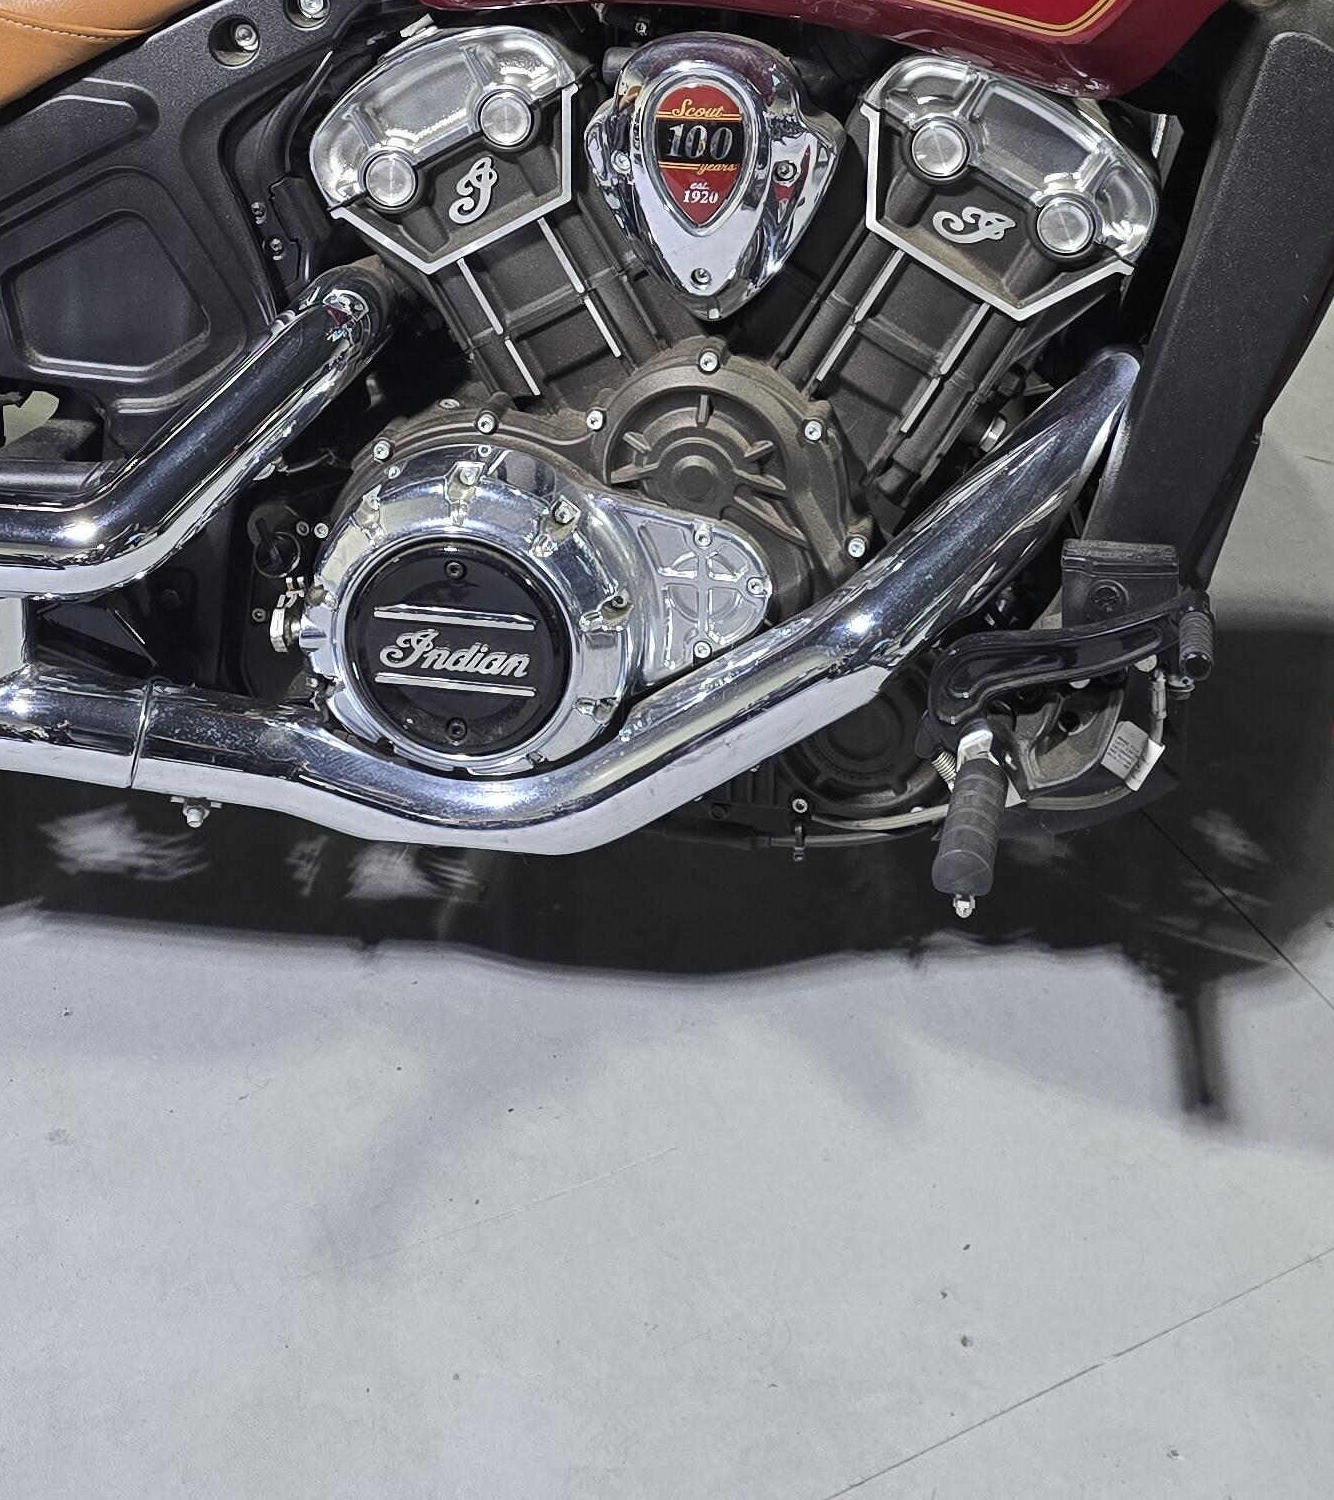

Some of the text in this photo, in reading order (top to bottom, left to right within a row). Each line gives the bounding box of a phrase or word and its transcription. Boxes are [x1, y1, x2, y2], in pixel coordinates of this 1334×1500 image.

[671, 98, 724, 118] Scout
[668, 123, 734, 160] 100
[698, 162, 737, 176] years
[683, 189, 719, 205] 1920
[379, 628, 531, 678] Indian
